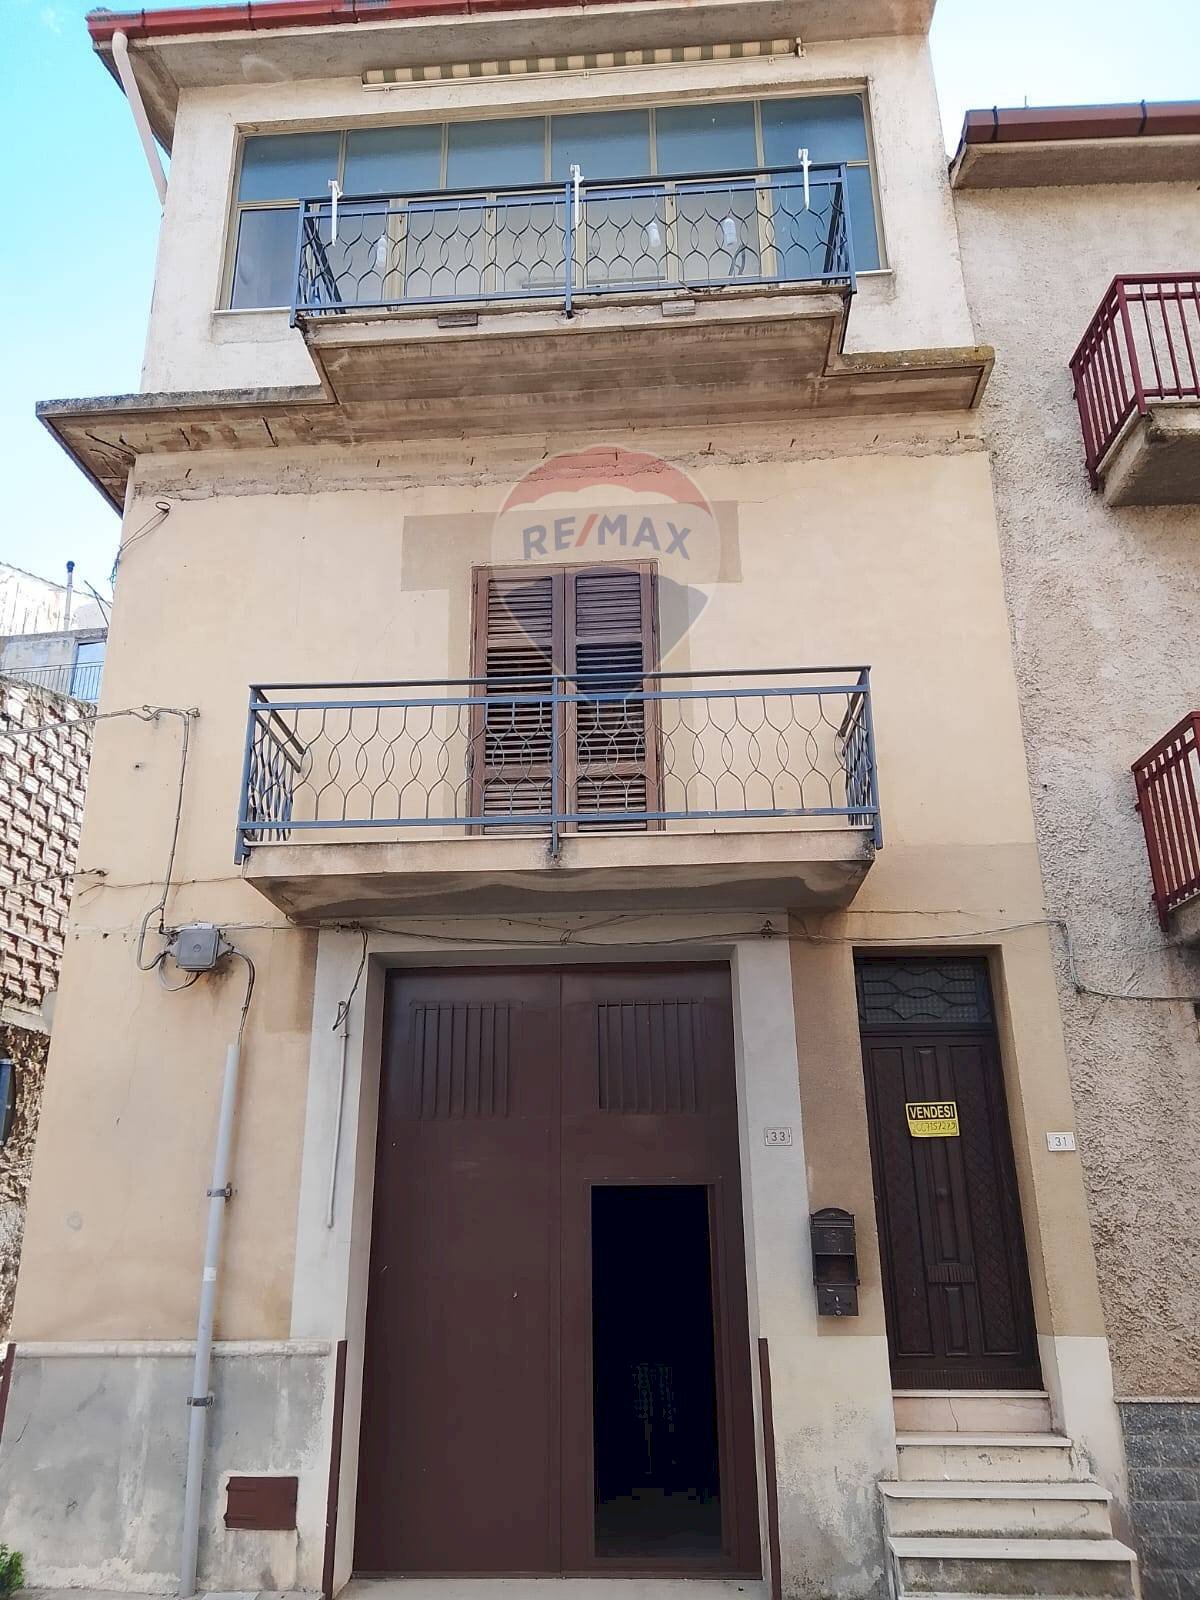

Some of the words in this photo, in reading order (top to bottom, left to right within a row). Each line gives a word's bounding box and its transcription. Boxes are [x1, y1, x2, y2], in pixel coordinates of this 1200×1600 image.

[909, 1105, 954, 1119] VENDESI
[771, 1131, 786, 1142] 33
[1054, 1136, 1067, 1147] 31
